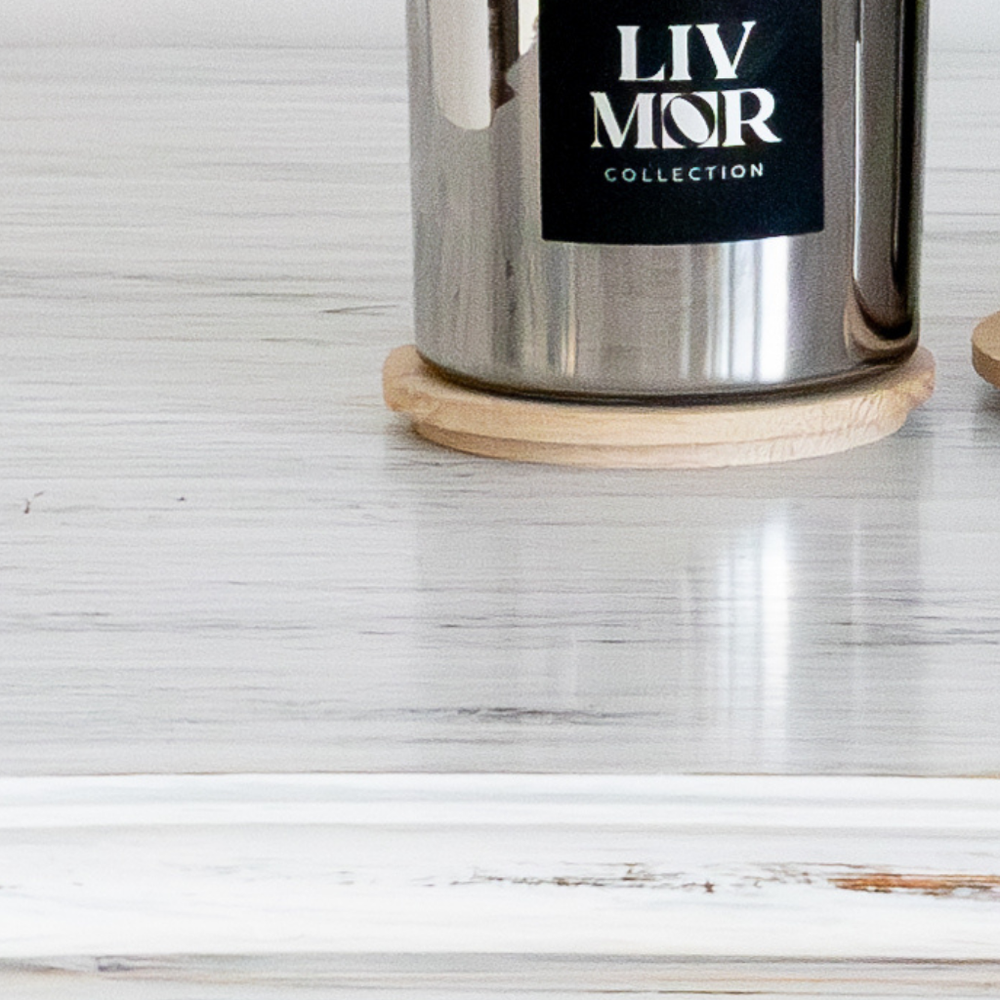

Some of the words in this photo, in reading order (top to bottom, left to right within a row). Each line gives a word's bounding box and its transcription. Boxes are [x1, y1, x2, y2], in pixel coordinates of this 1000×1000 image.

[616, 20, 757, 81] LIV
[589, 87, 782, 149] MOR
[604, 162, 764, 182] COLLECTION
